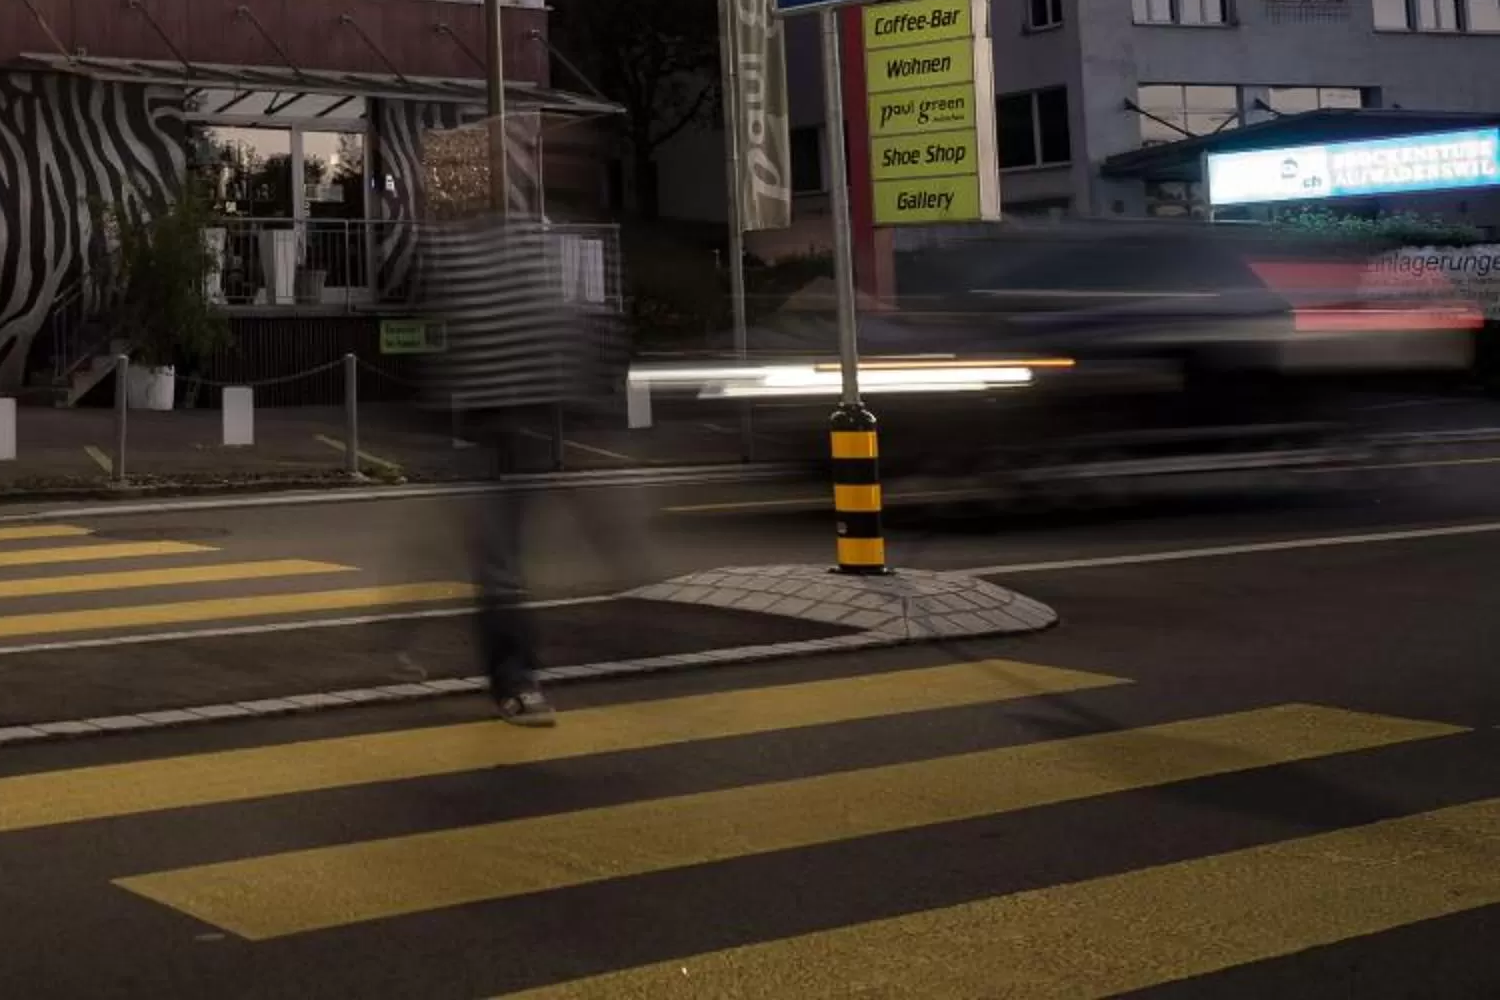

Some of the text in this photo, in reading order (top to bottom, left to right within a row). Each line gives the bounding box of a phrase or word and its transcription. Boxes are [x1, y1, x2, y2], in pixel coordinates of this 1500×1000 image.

[874, 9, 962, 36] Coffee-Bar
[887, 56, 952, 79] Wohnen
[880, 97, 965, 129] paul green
[882, 145, 967, 168] Shoe Shop
[896, 191, 955, 212] Gallery
